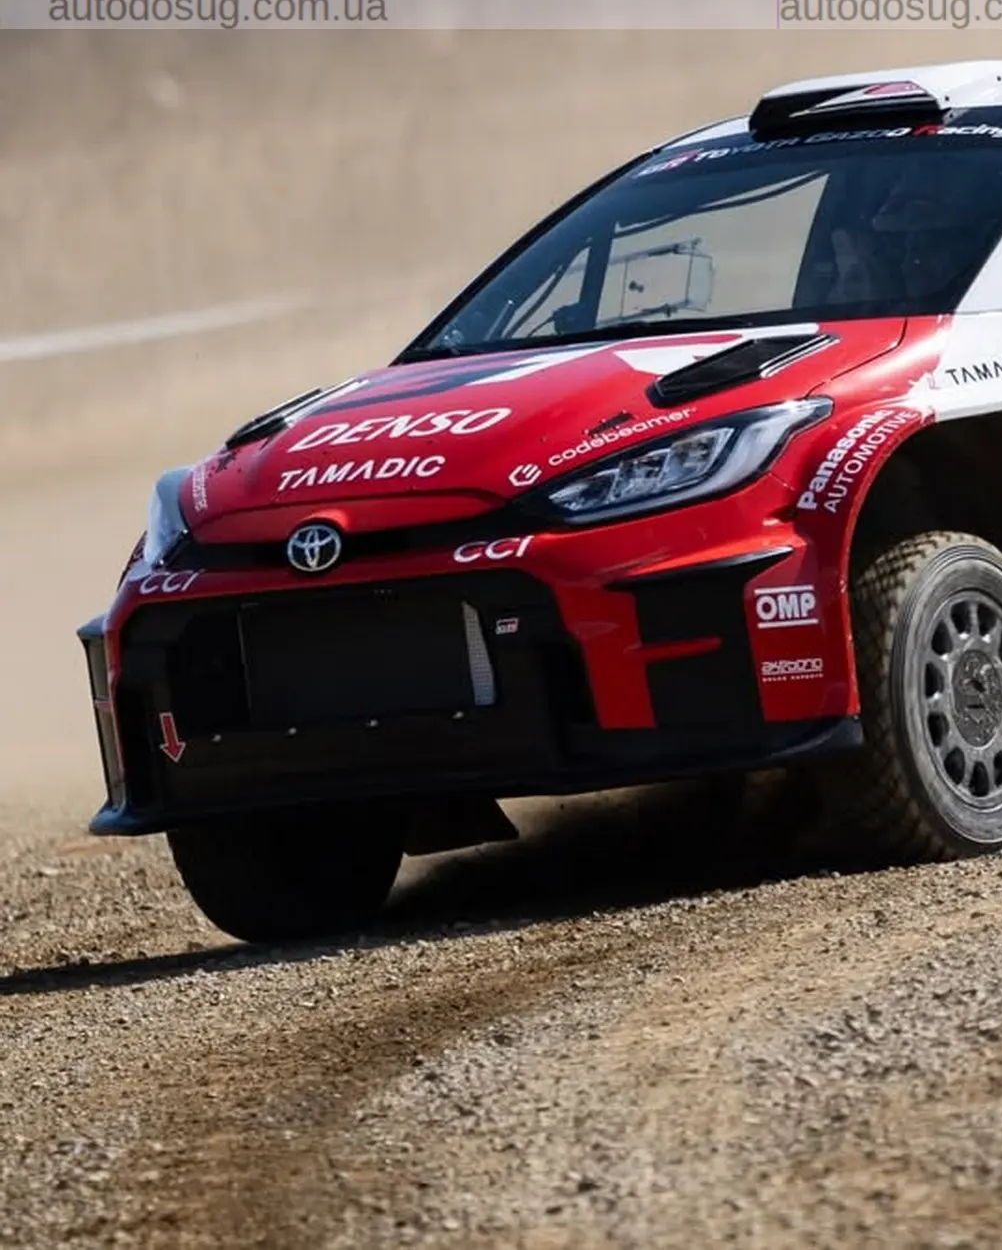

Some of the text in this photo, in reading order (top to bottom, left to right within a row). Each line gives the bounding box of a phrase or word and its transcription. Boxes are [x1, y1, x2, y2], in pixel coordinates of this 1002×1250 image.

[286, 406, 512, 453] DENSO
[277, 455, 446, 491] TAMADIC
[797, 408, 894, 511] Panasonic
[823, 410, 919, 514] AUTOMOTIVE
[756, 591, 816, 621] OMP
